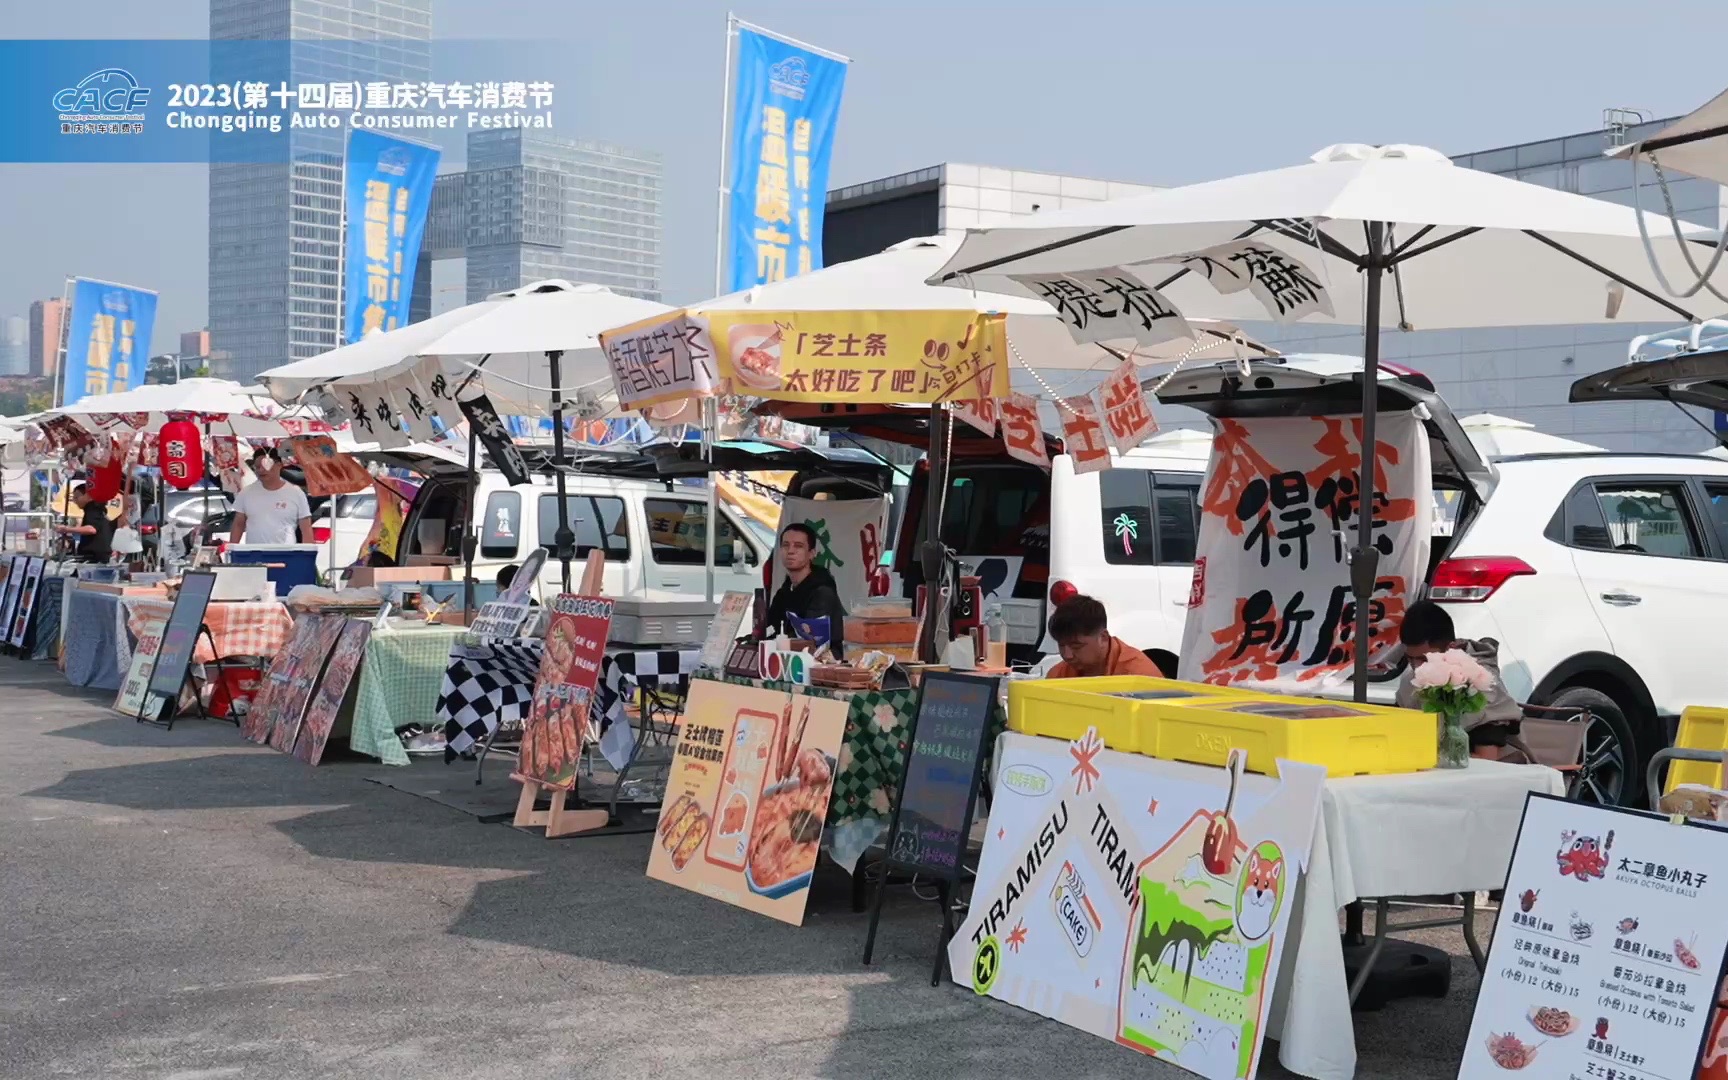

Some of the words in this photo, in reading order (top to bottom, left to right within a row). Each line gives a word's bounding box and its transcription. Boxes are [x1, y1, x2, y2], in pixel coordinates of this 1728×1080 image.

[971, 801, 1069, 944] TIRAMISU
[1617, 858, 1708, 888] 太二章鱼小丸子
